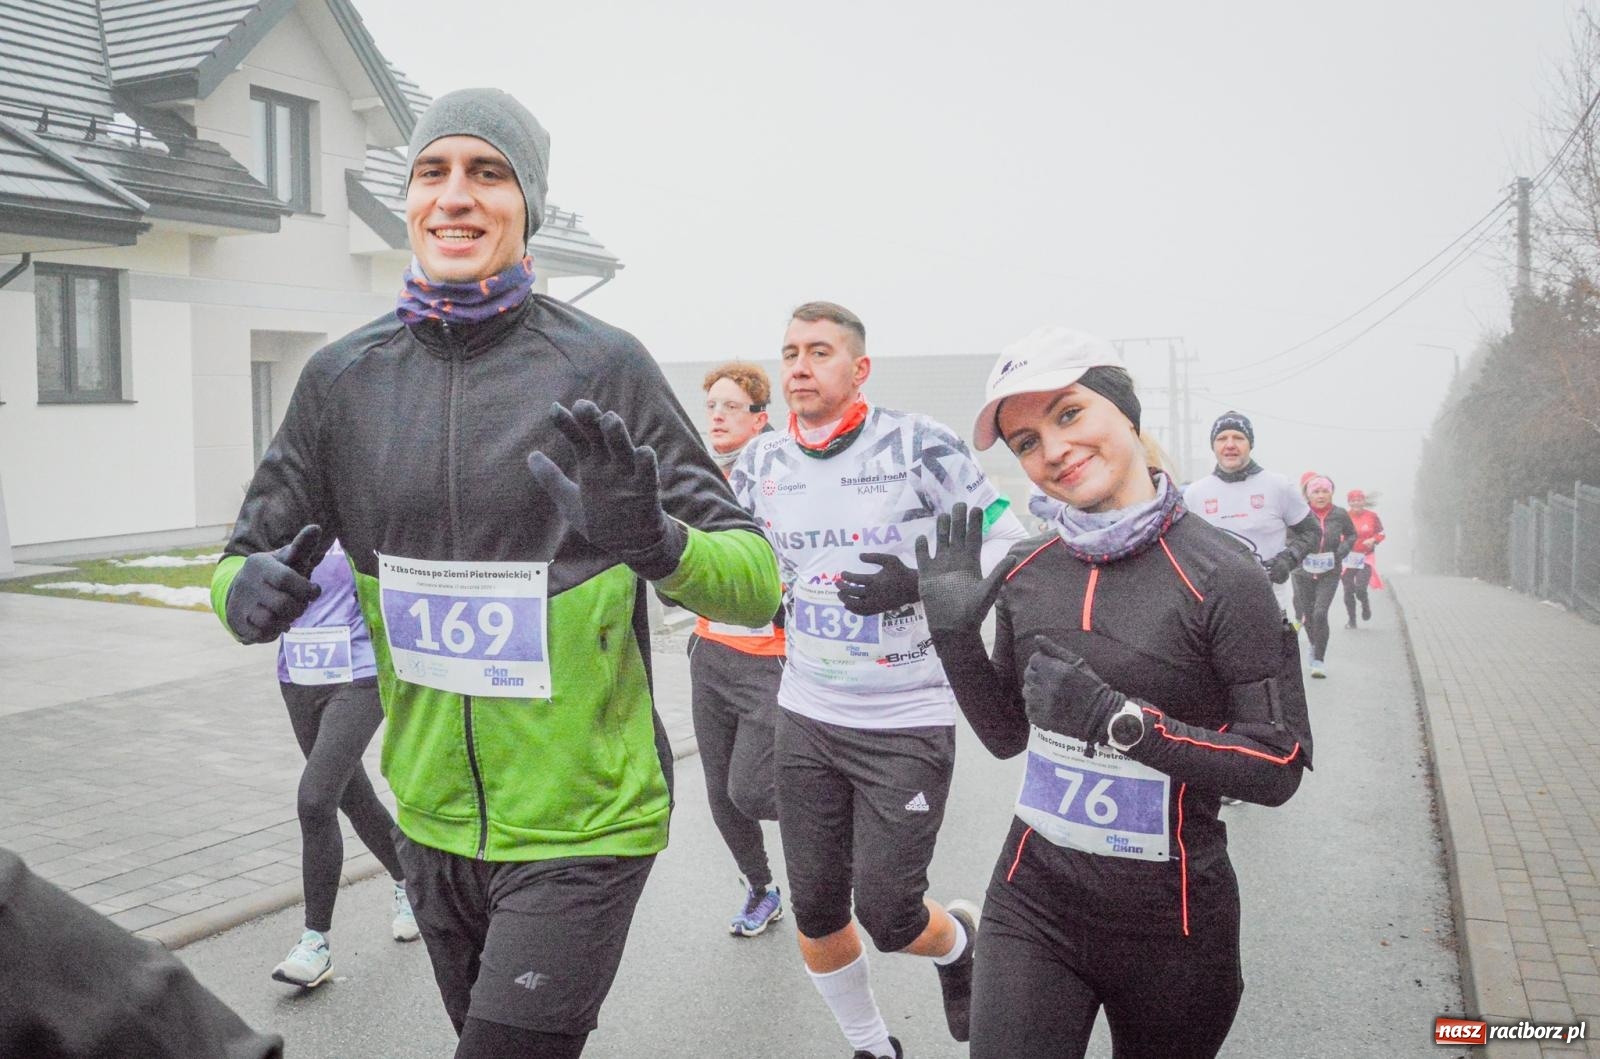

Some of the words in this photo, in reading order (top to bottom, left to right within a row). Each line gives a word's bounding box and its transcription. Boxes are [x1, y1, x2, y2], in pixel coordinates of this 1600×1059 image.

[777, 482, 807, 492] Gogolin
[857, 485, 889, 495] KAMIL
[409, 568, 431, 577] Cross
[432, 570, 442, 579] po
[443, 570, 469, 579] Ziemi
[470, 570, 532, 581] Pietrowickiej
[408, 598, 514, 656] 169
[804, 604, 864, 640] 139
[292, 642, 337, 668] 157
[885, 650, 928, 663] Brick
[1049, 738, 1066, 749] Cross
[1066, 744, 1076, 752] po
[1054, 767, 1118, 825] 76
[514, 970, 548, 990] 4F
